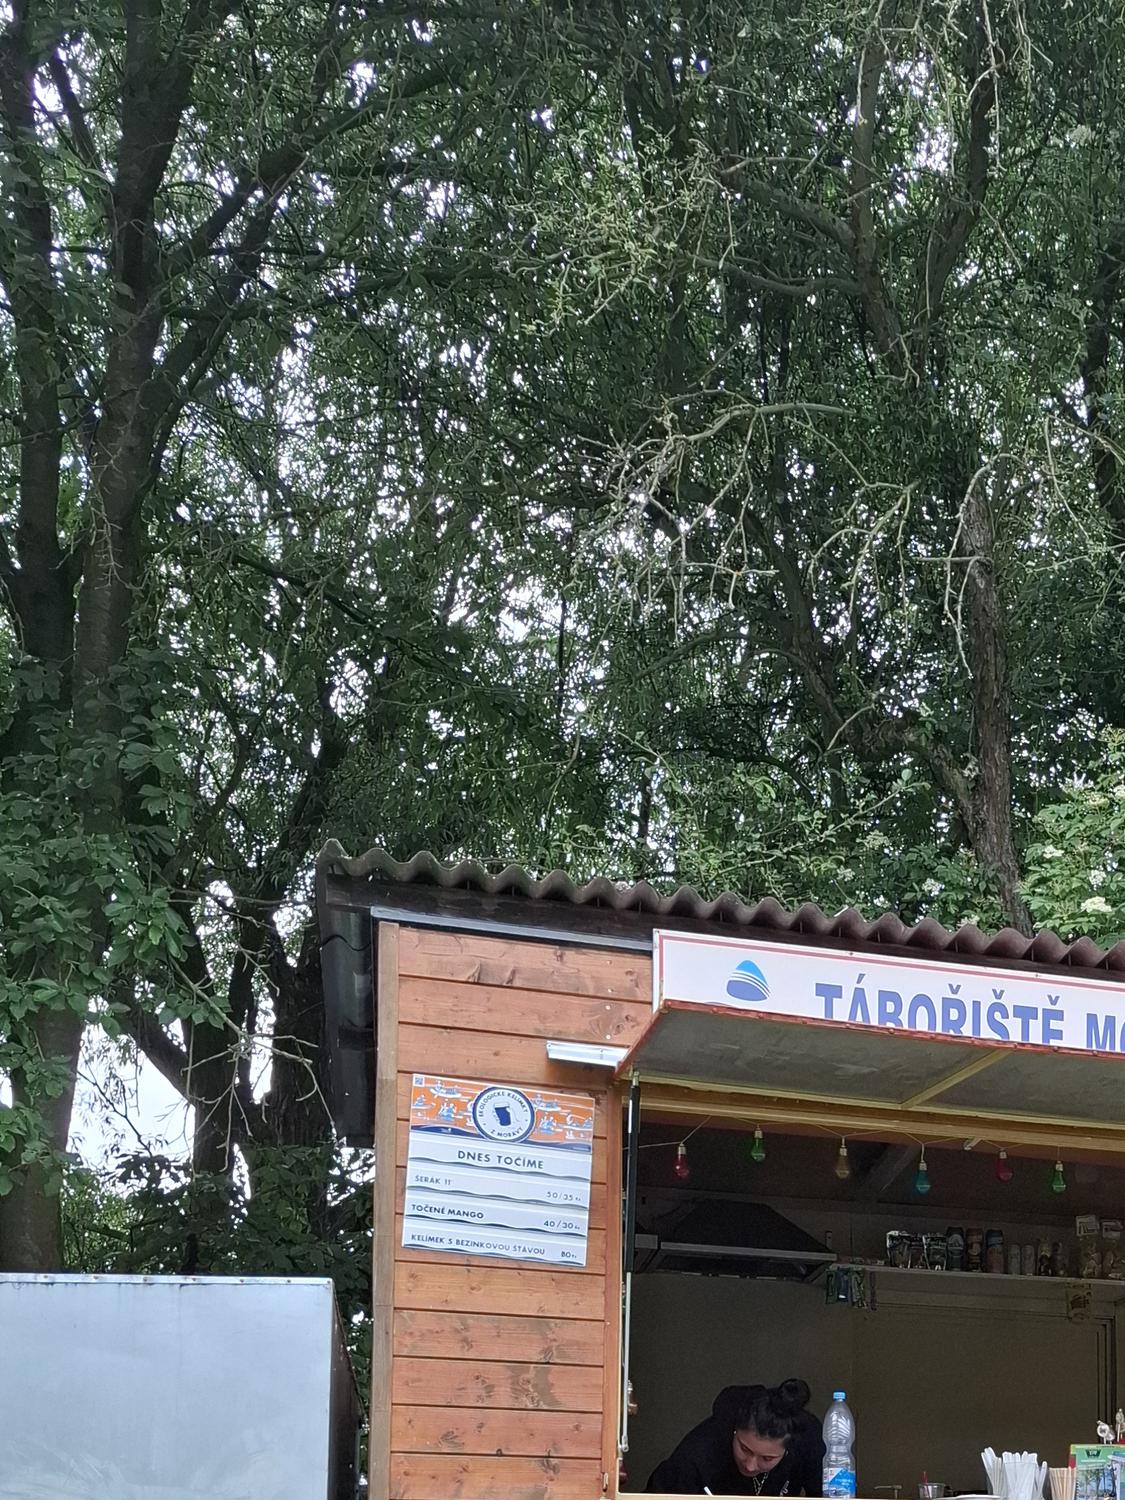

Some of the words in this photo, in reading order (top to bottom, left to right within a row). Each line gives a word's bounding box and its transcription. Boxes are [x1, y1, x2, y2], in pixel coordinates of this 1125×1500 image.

[815, 973, 1065, 1045] TÁBOŘIŠTĚ
[457, 1150, 490, 1162] DNES
[497, 1155, 544, 1169] TOČÍME
[411, 1203, 446, 1215] TOČENÉ
[447, 1208, 485, 1219] MANGO
[543, 1220, 574, 1230] 40/30
[411, 1234, 445, 1244] KELÍMEK
[455, 1238, 510, 1250] BEZINKOVOU
